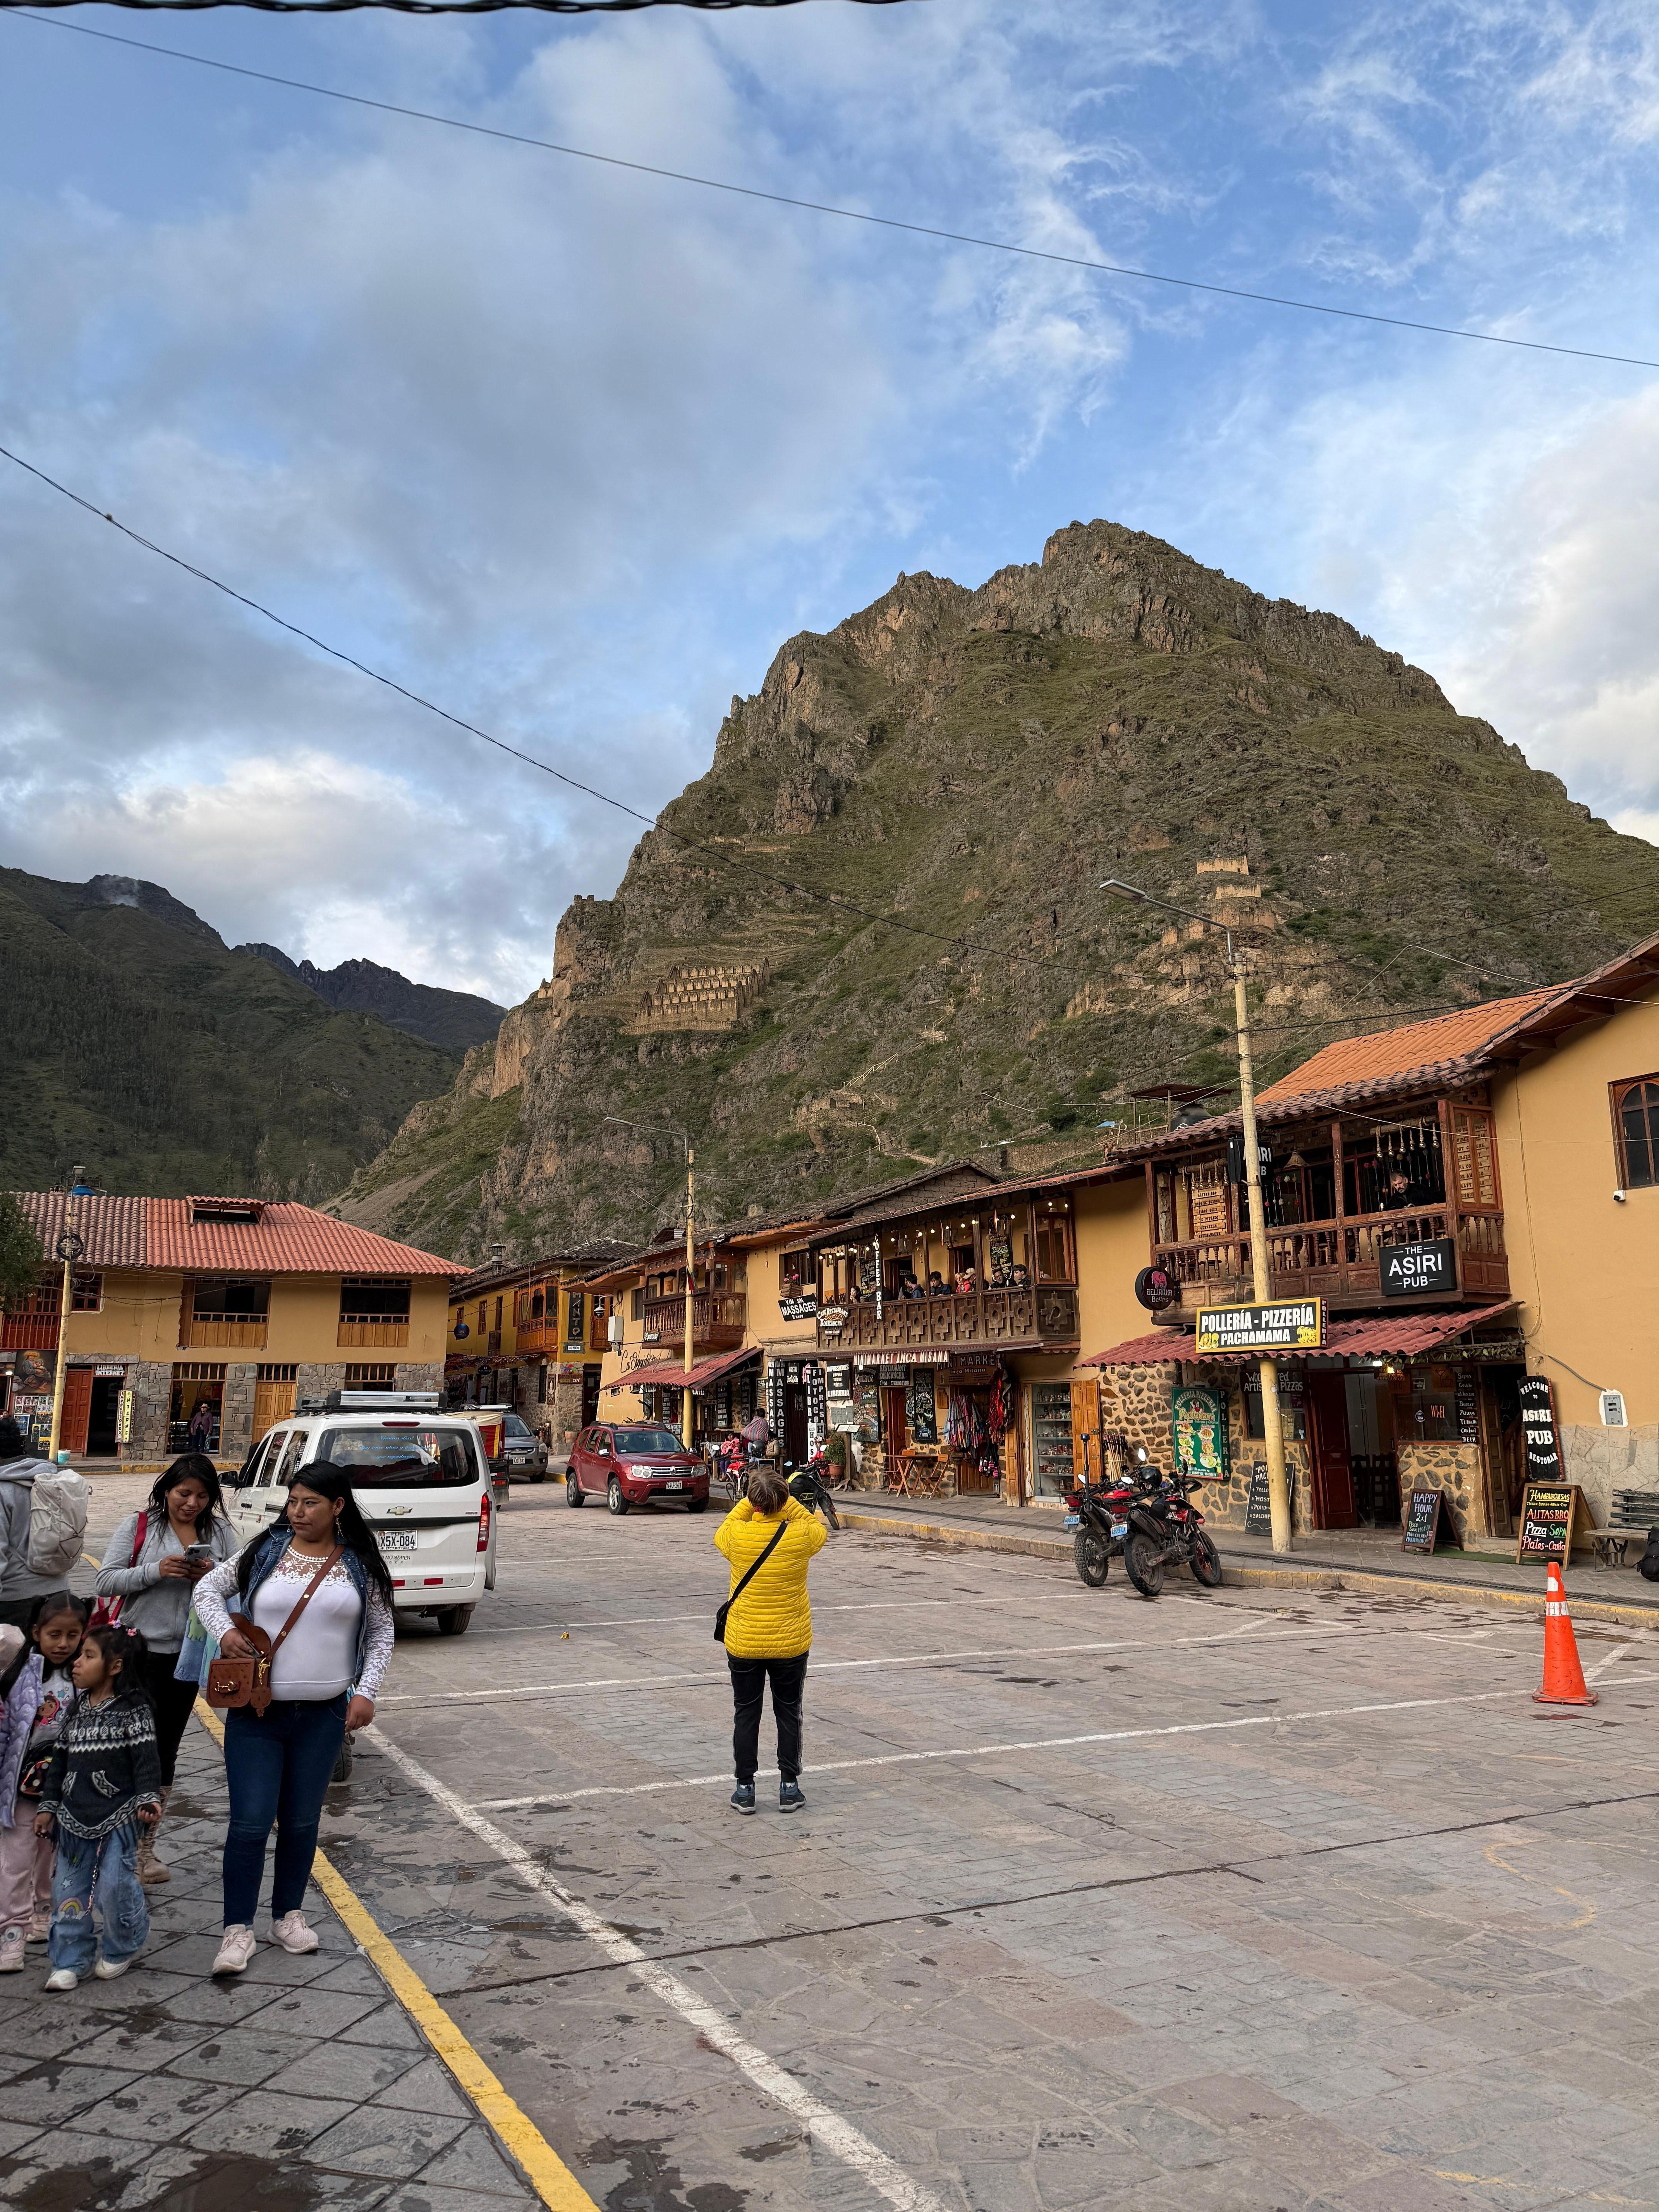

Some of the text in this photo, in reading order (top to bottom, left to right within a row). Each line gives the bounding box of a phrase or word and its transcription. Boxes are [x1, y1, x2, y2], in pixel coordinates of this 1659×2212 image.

[1405, 1245, 1423, 1255] THE
[1389, 1253, 1442, 1276] ASIRI
[1403, 1276, 1428, 1288] PUB
[781, 1301, 816, 1316] MASSAGES
[1201, 1304, 1314, 1333] POLLERÍA PIZZERÍA
[1221, 1329, 1290, 1345] PACHAMAMA
[896, 1352, 917, 1363] INCA
[919, 1350, 948, 1360] MISANA
[1520, 1381, 1549, 1395] WELCOME
[776, 1369, 785, 1448] MASSAGES
[1523, 1409, 1552, 1422] ASIRI
[1220, 1391, 1230, 1477] POLLERIA
[1527, 1431, 1553, 1445] PUB
[1529, 1452, 1558, 1465] RESTOBAR
[1413, 1493, 1437, 1503] HAPPY
[1414, 1503, 1432, 1513] HOUR
[1526, 1509, 1554, 1519] ALITAS
[1416, 1513, 1427, 1522] 2x1
[380, 1535, 415, 1547] X5X-084
